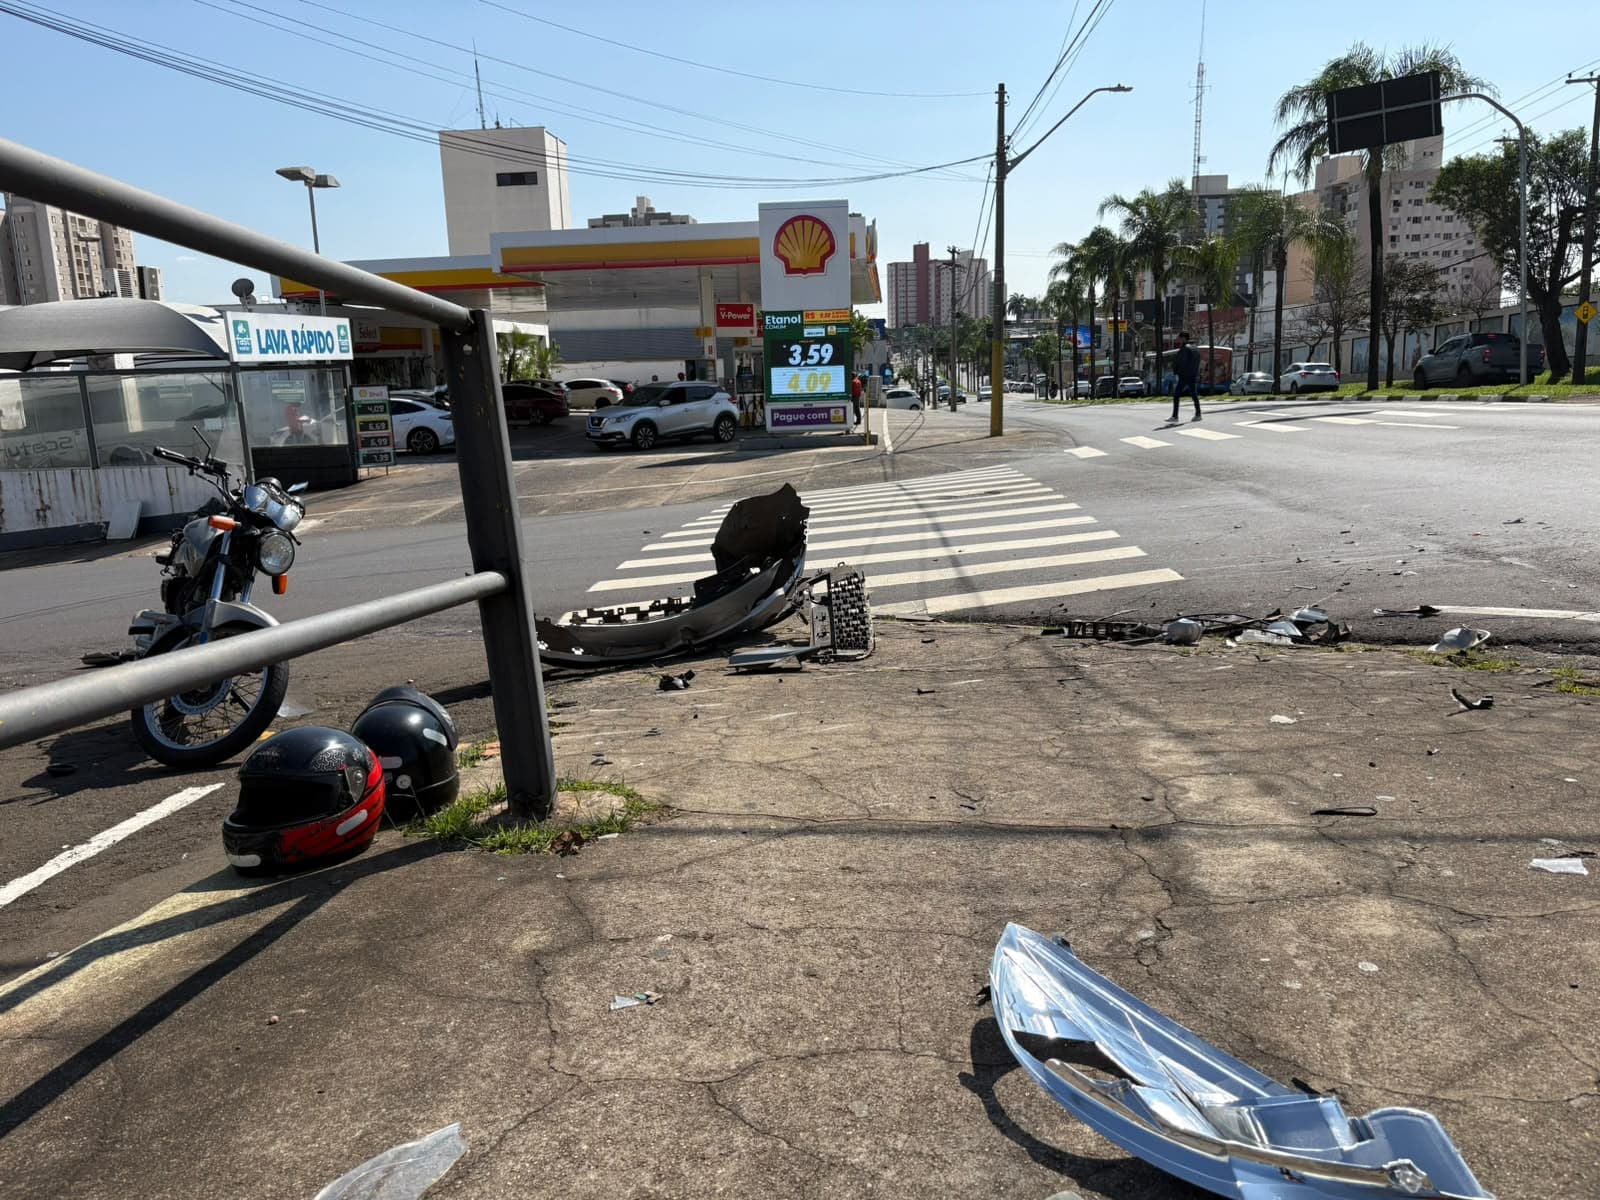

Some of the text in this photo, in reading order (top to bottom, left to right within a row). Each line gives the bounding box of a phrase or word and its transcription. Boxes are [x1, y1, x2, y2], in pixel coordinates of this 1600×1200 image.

[720, 311, 751, 320] V-Power
[765, 314, 801, 325] Etanol
[256, 323, 335, 355] LAVA RÁPIDO
[788, 343, 834, 367] 3,59
[773, 412, 805, 423] Pague
[807, 412, 828, 420] com
